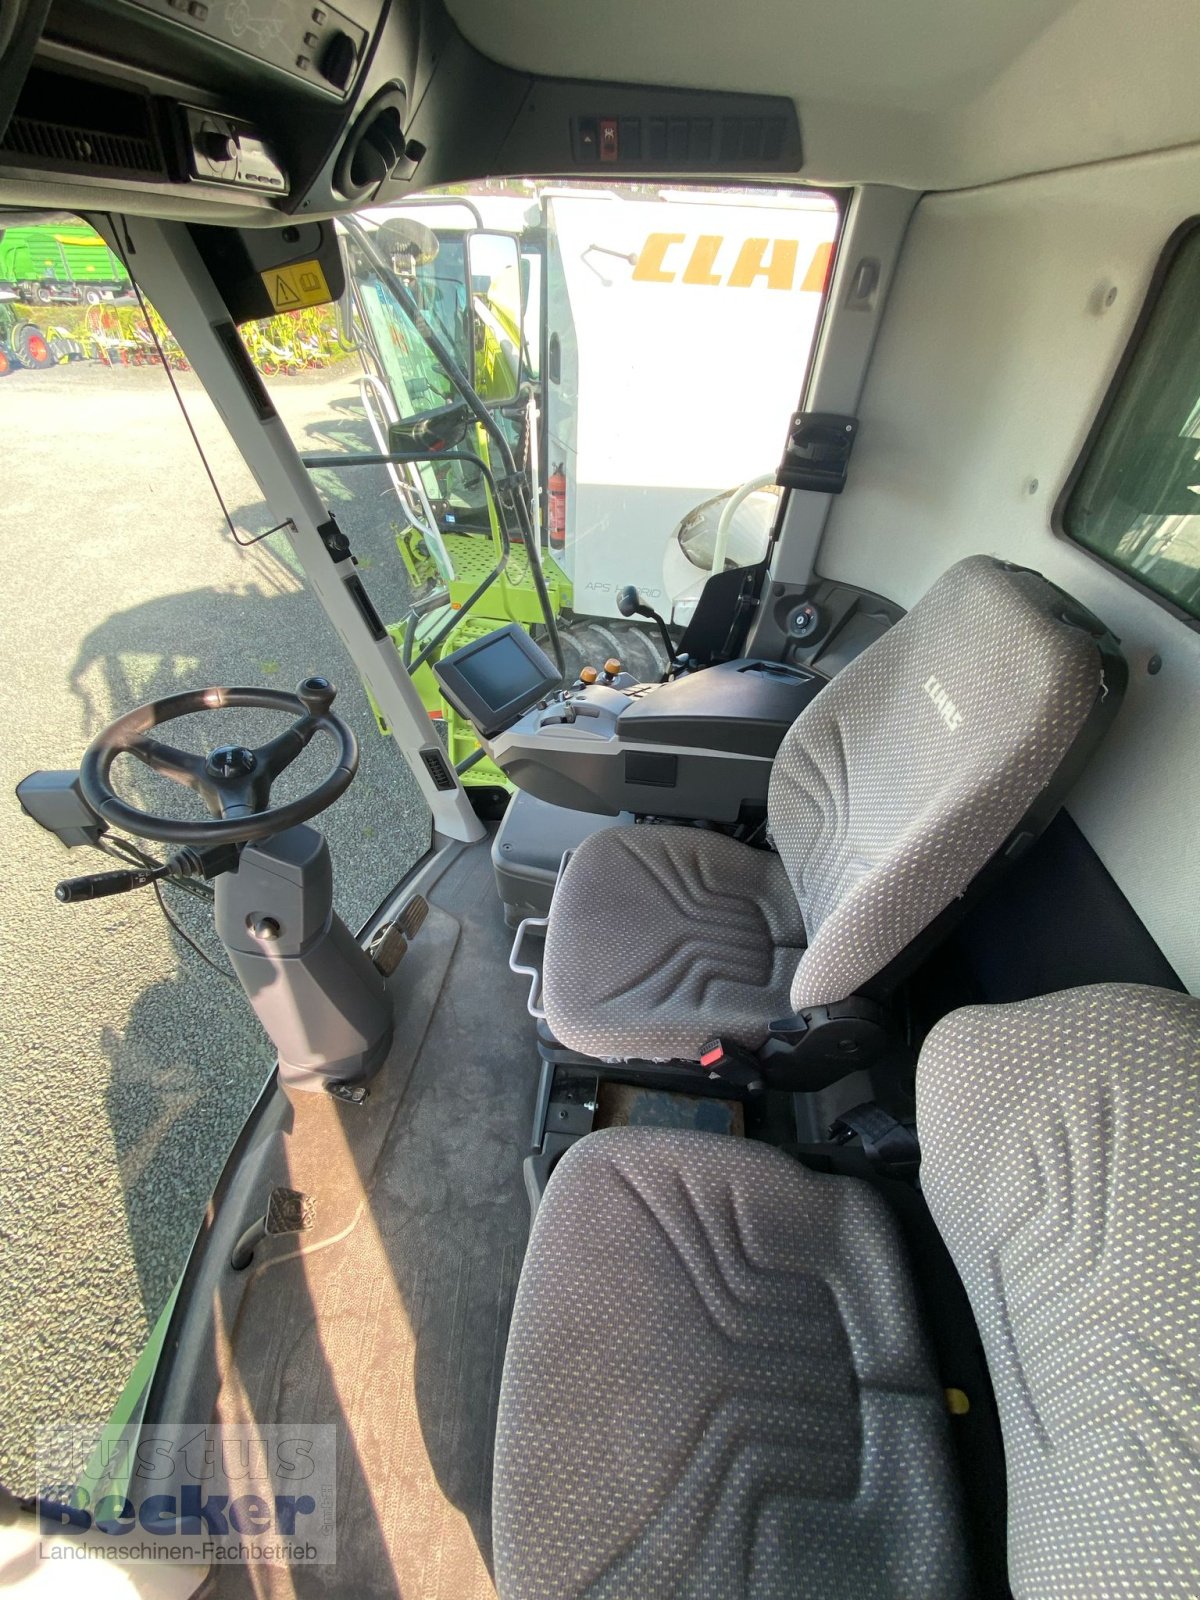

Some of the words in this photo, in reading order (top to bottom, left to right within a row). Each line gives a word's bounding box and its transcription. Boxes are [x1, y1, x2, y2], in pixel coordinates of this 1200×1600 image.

[585, 582, 611, 593] APS
[615, 584, 662, 598] HRID
[924, 675, 962, 731] CLAAS
